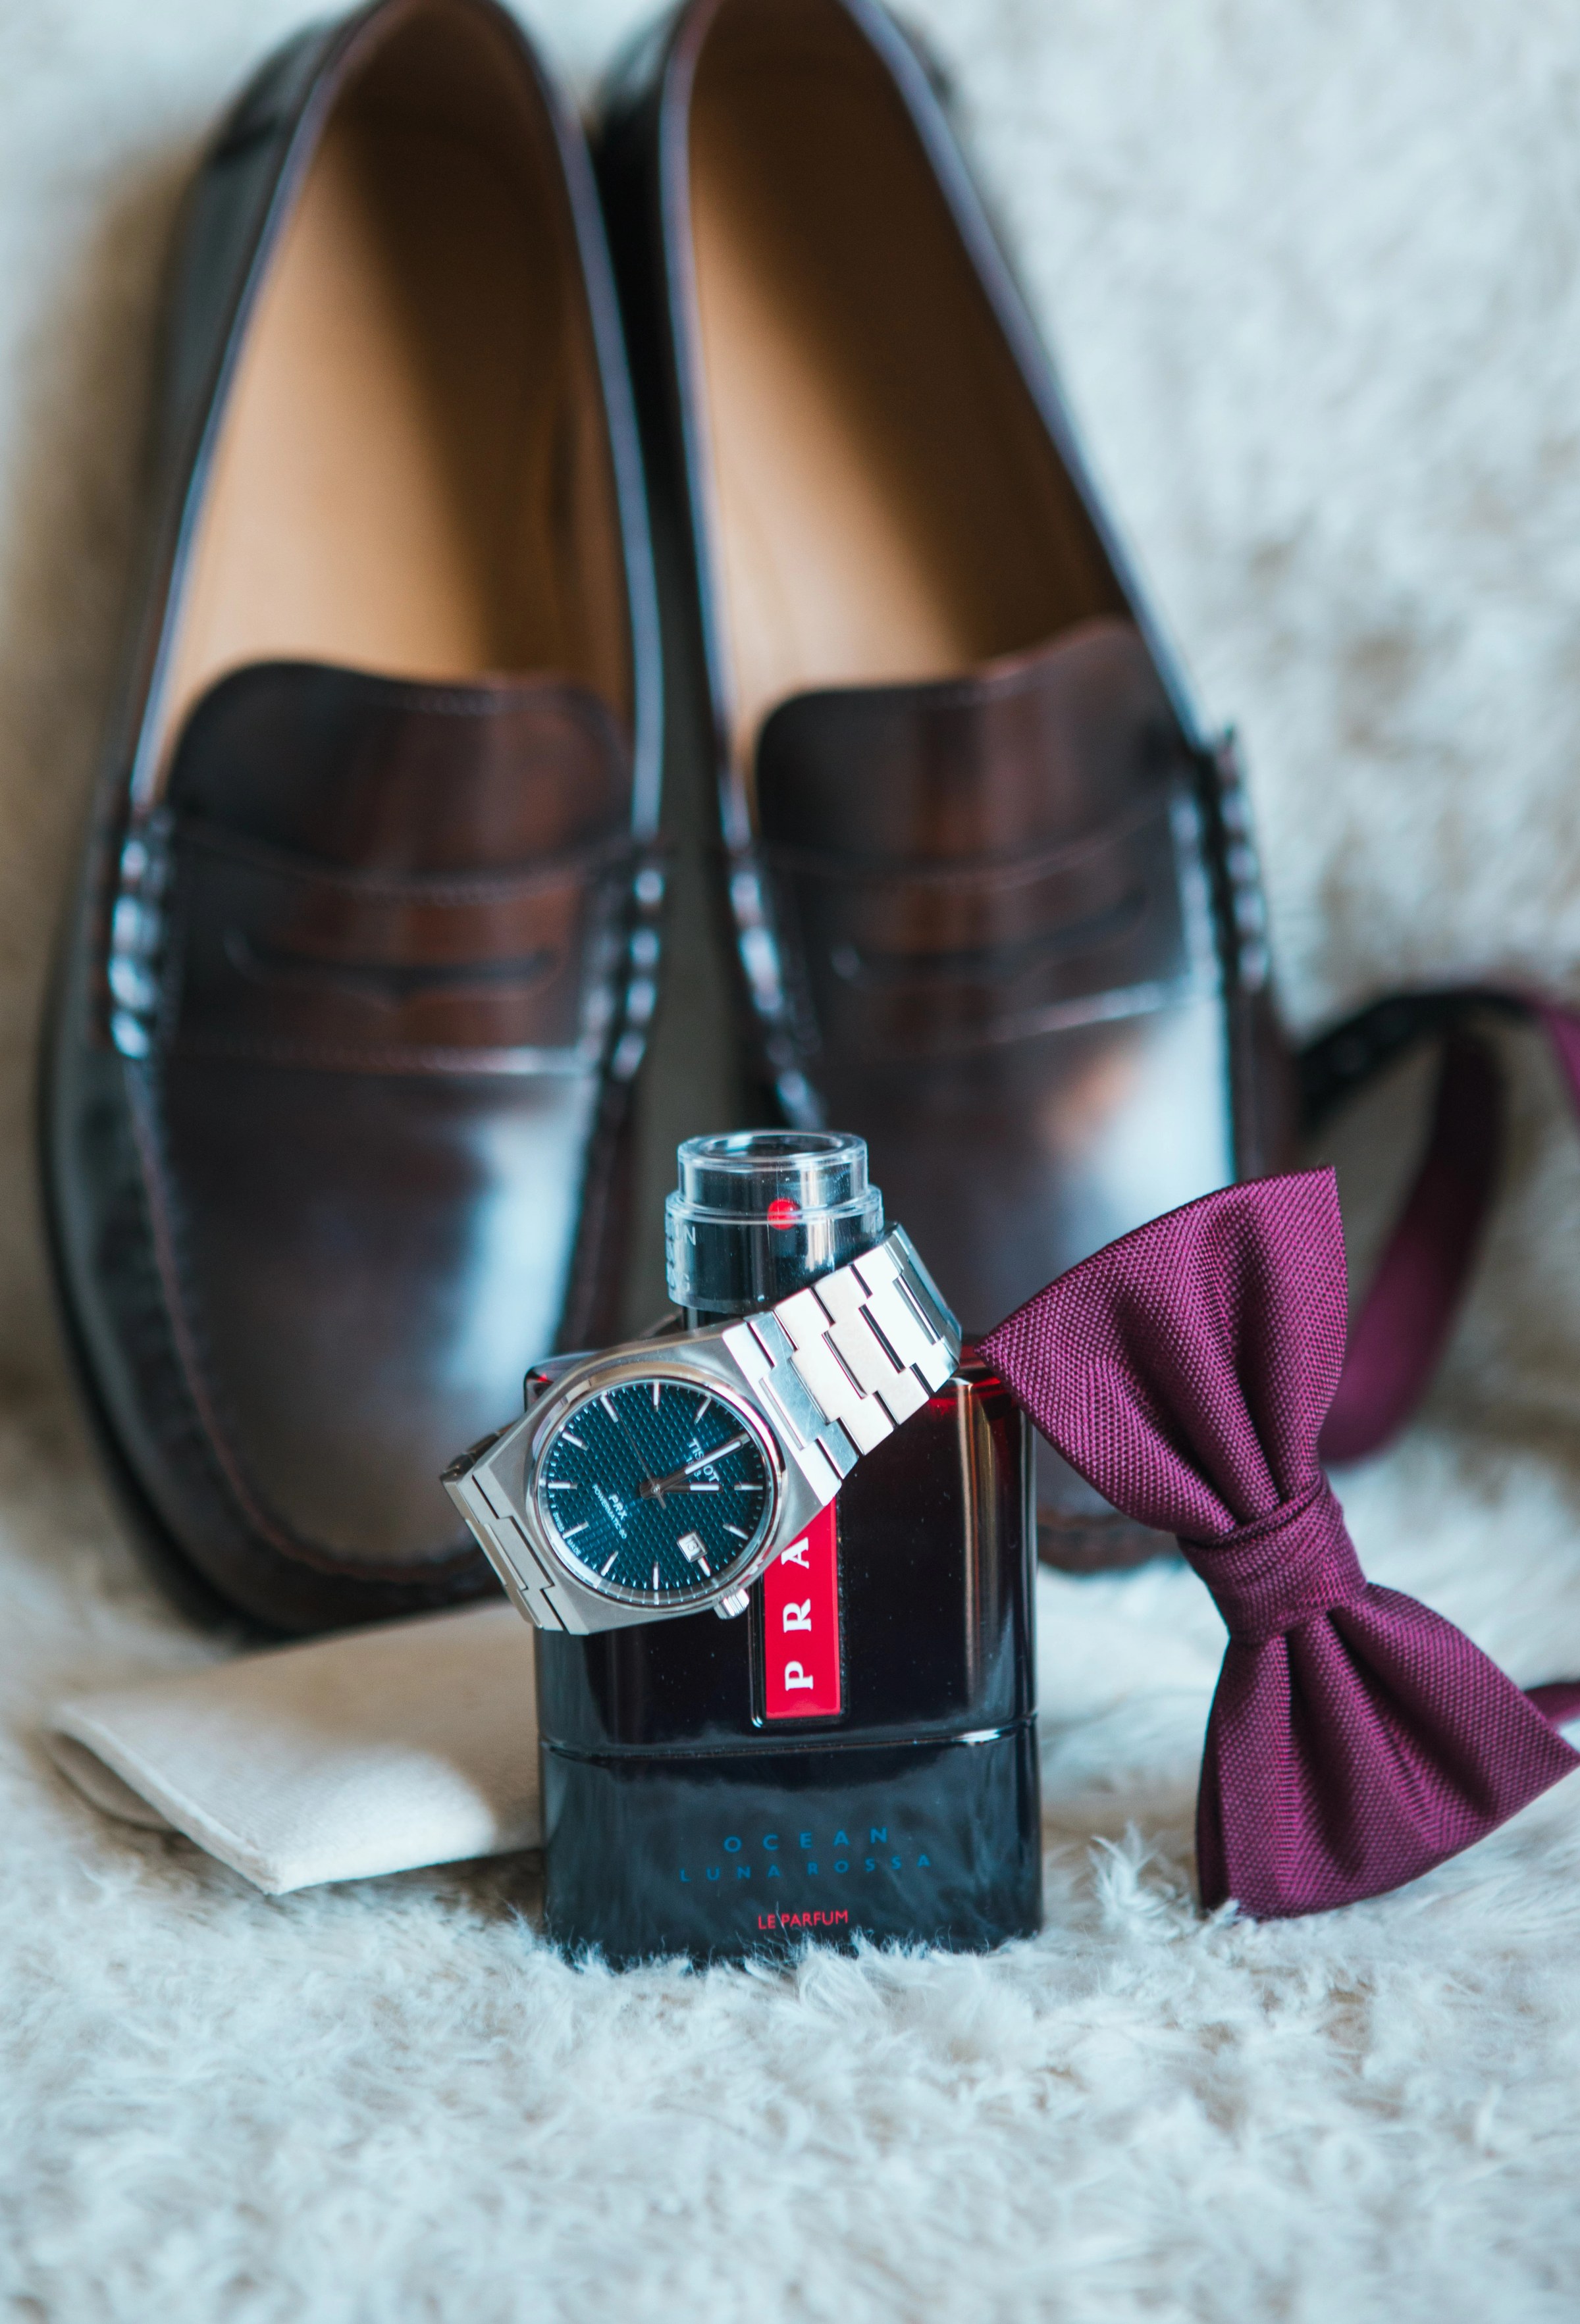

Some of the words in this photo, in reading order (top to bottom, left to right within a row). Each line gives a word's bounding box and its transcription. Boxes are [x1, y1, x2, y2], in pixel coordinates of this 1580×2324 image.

[689, 1437, 720, 1482] TISOT
[592, 1484, 621, 1530] POWERMATIC
[608, 1493, 627, 1520] PRX
[553, 1512, 565, 1532] SWISS
[567, 1539, 581, 1557] MADE
[723, 1826, 888, 1853] OCEAN
[679, 1864, 781, 1882] LUNA
[807, 1853, 931, 1876] ROSSA
[758, 1913, 776, 1930] LE
[781, 1909, 849, 1928] PARFUM
